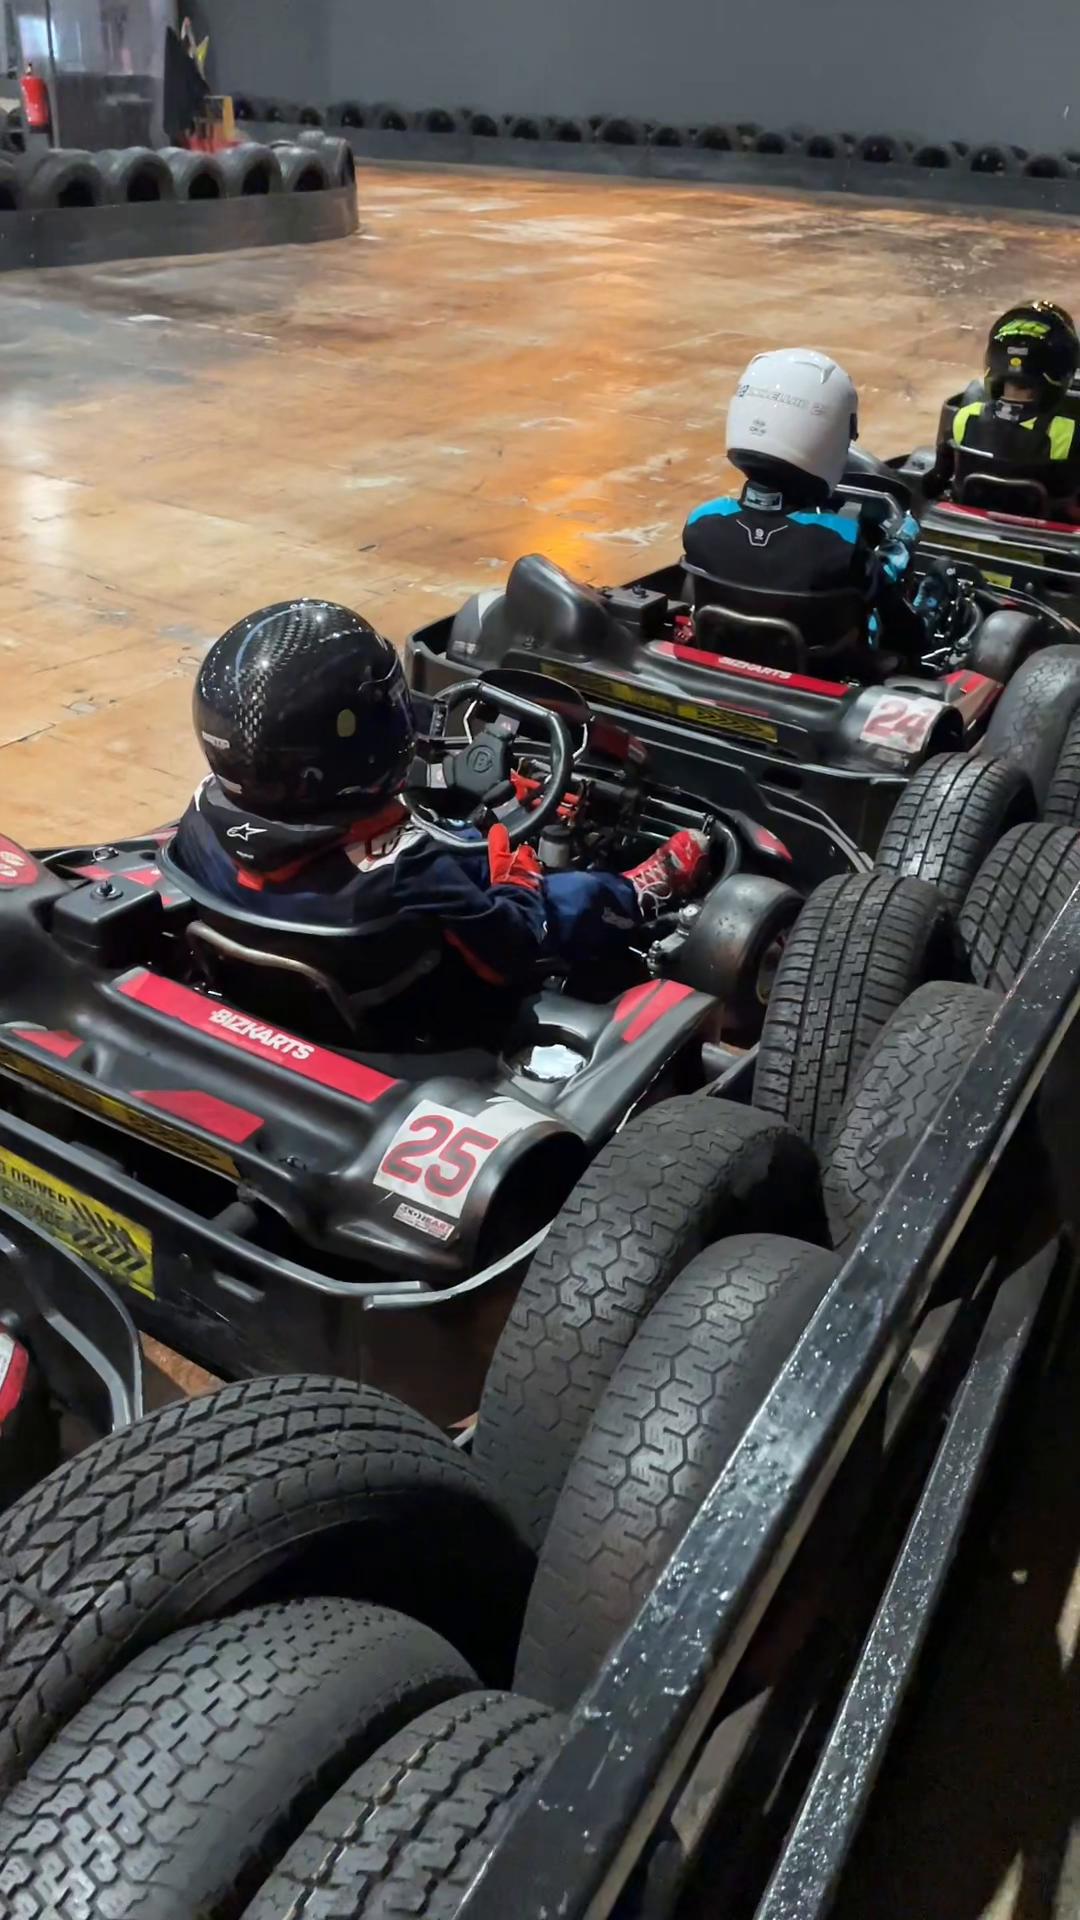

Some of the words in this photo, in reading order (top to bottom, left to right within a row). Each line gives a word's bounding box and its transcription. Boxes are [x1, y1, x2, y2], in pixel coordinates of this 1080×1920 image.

[863, 699, 936, 746] 24
[208, 1008, 315, 1060] BIZKARTS
[381, 1114, 500, 1198] 25
